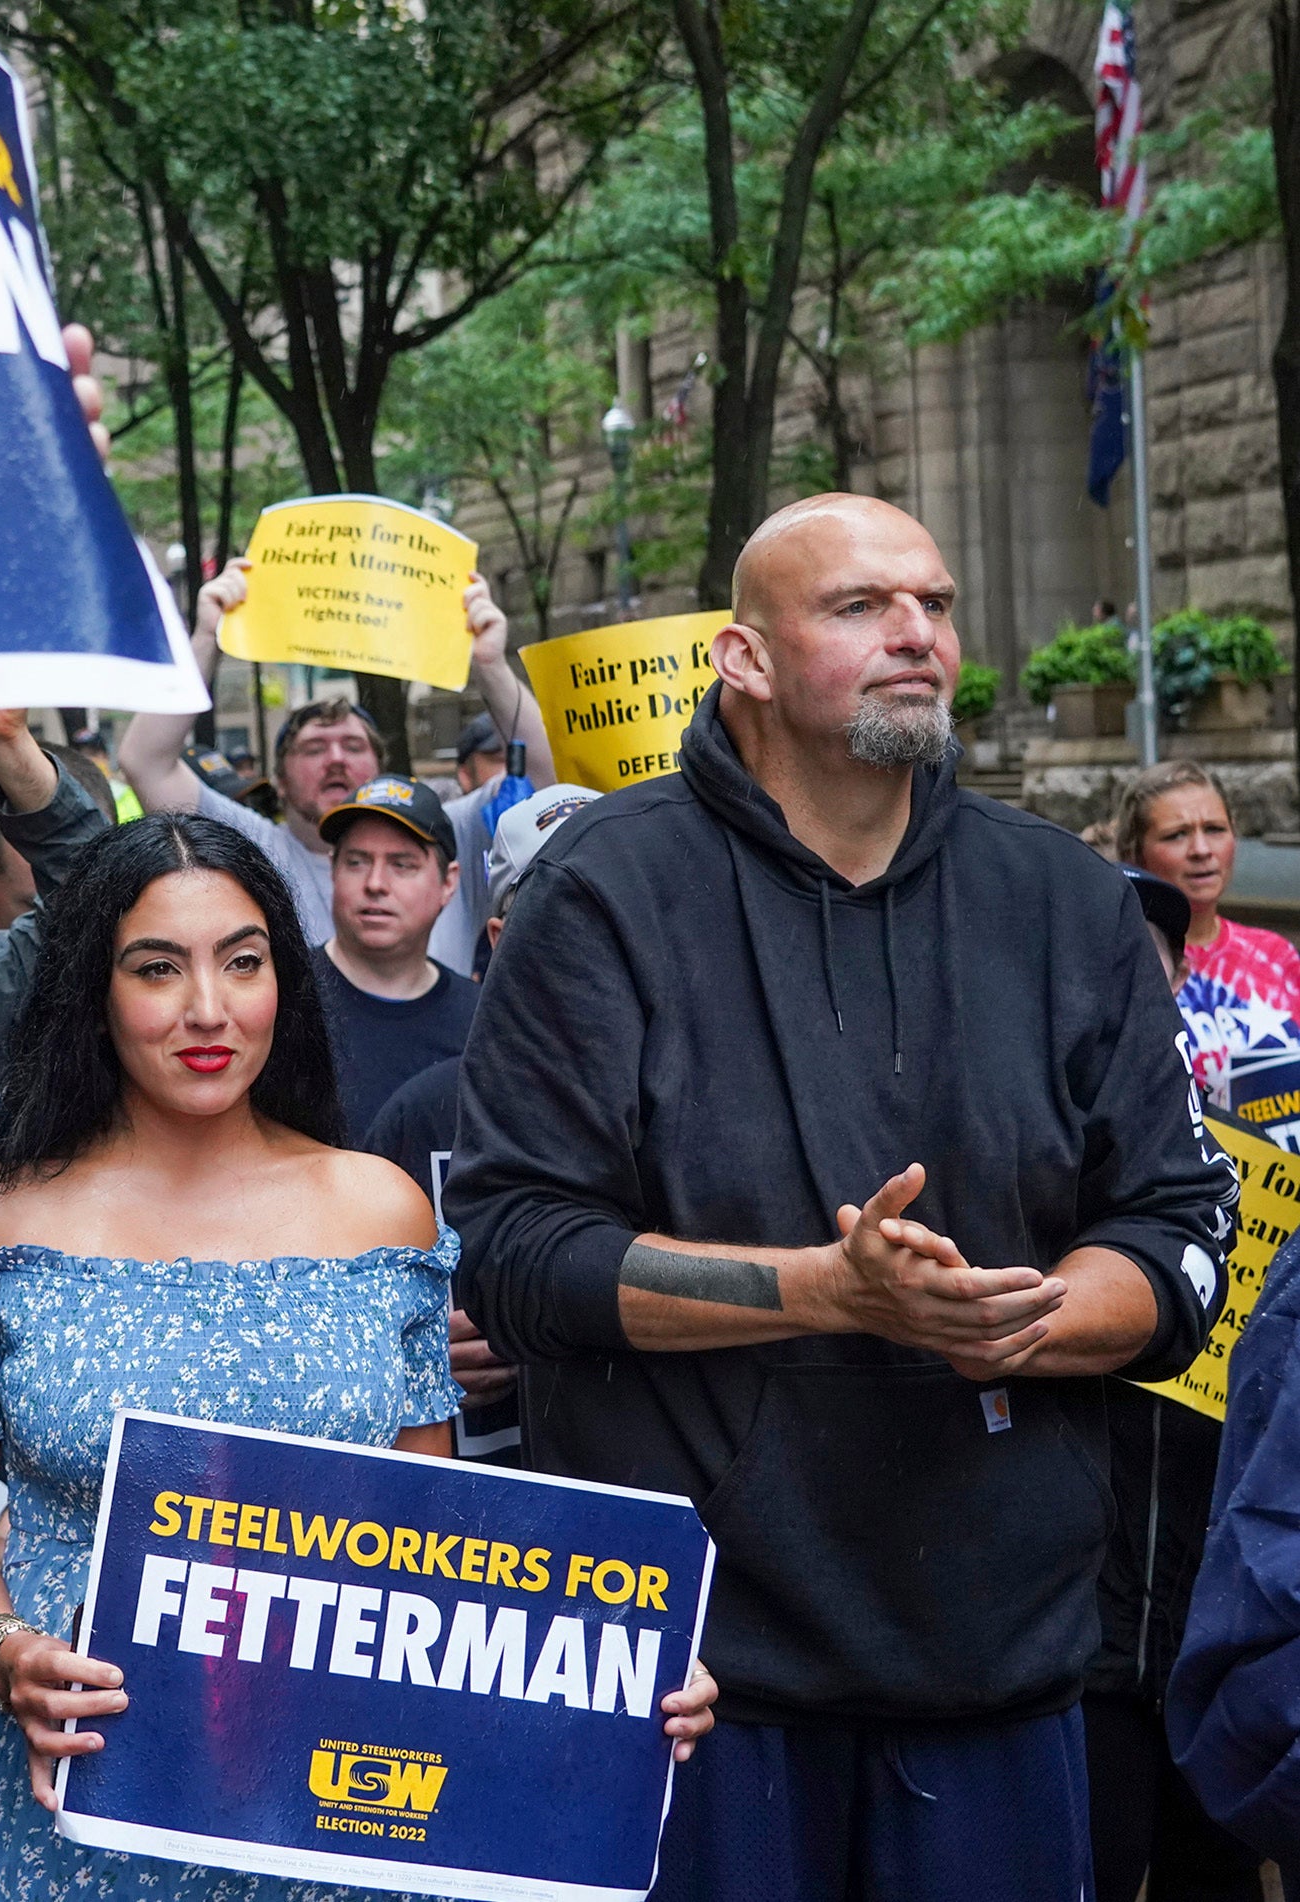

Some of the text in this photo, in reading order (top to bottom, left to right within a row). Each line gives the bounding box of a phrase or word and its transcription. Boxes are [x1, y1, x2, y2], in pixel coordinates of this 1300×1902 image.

[285, 521, 441, 556] Fair pay for the
[261, 548, 336, 566] District
[297, 586, 404, 610] VICTIMS have
[303, 605, 350, 625] rights
[570, 657, 622, 689] Fair
[629, 652, 682, 686] pay
[565, 698, 641, 734] Public
[149, 1490, 669, 1612] STEELWORKERS FOR
[132, 1553, 662, 1719] FETTERMAN
[319, 1738, 443, 1764] UNITED STEELWORKERS
[308, 1749, 449, 1813] USW
[318, 1800, 428, 1821] UNITY AND STRENGTH FOR WORKERS
[316, 1815, 427, 1842] ELECTION 2022
